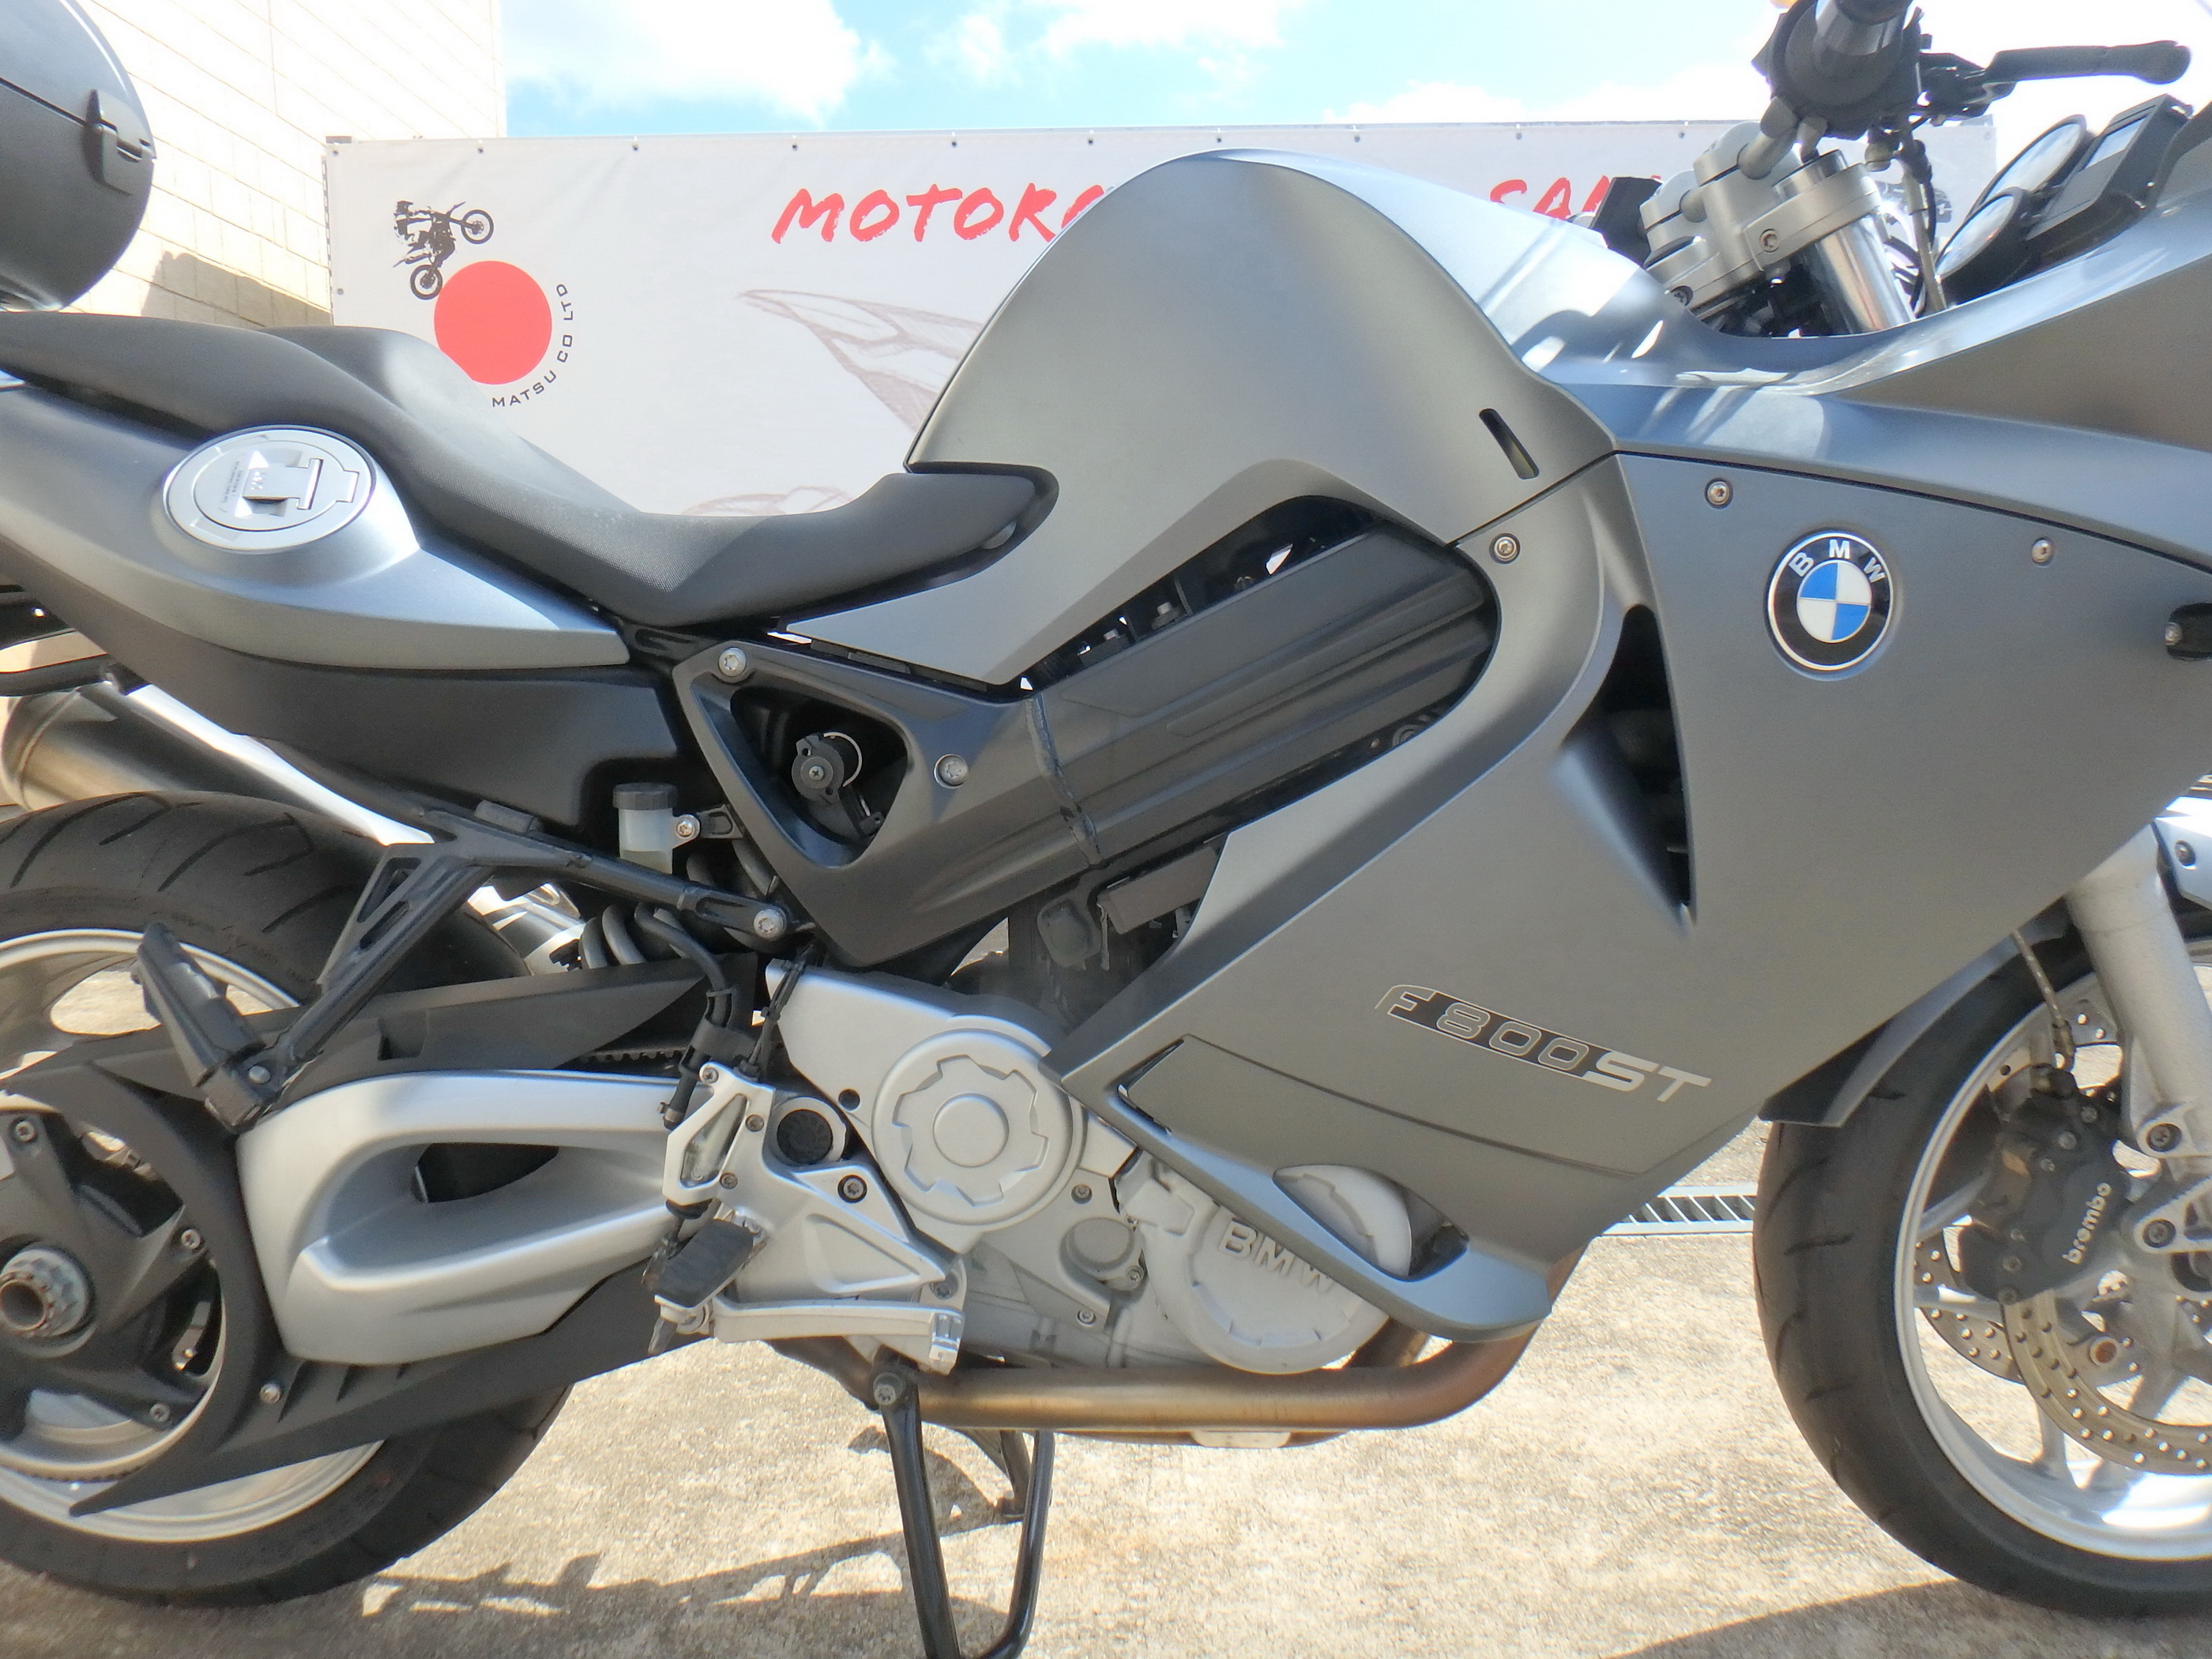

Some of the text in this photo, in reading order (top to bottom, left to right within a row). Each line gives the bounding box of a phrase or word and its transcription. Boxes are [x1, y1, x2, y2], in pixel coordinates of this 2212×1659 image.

[492, 284, 574, 408] MATSU CO LTD
[1788, 539, 1886, 583] BMW
[2062, 1183, 2112, 1264] brembo
